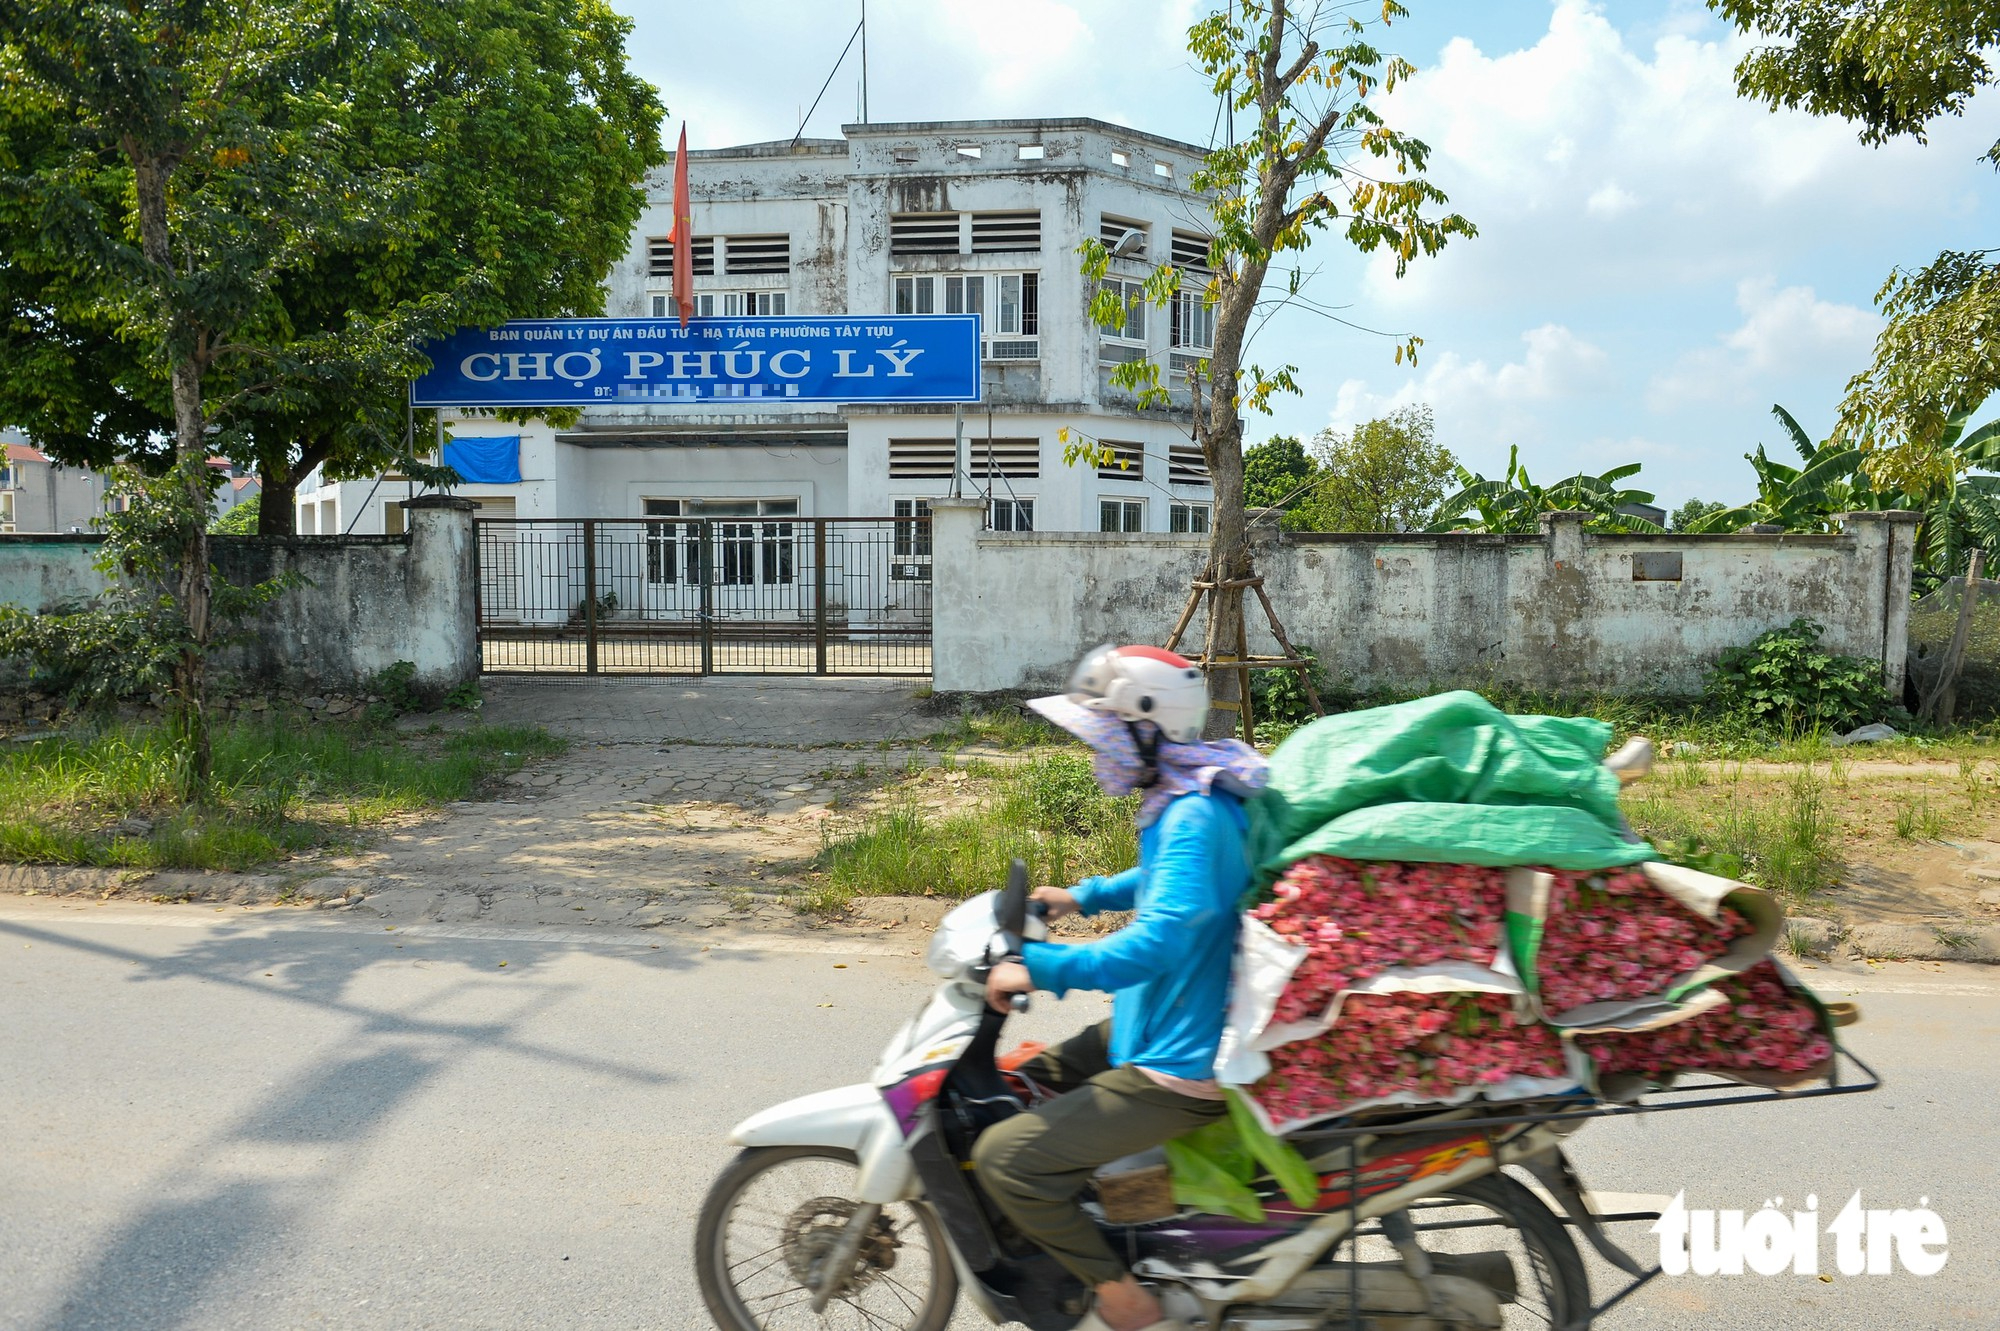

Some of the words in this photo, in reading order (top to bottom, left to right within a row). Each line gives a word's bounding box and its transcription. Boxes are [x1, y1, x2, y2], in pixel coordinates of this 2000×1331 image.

[489, 330, 520, 341] BAN
[524, 326, 564, 341] QUẢN
[568, 327, 585, 340] LÝ
[588, 328, 610, 341] DỰ
[612, 327, 633, 339] ÁN
[670, 327, 690, 339] TƯ
[703, 327, 723, 340] HẠ
[770, 324, 830, 338] PHƯỜNG
[834, 324, 861, 337] TÂY
[865, 325, 894, 339] TỰU
[460, 347, 602, 388] CHỢ
[622, 340, 811, 379] PHÚC
[832, 339, 925, 377] LÝ
[594, 386, 613, 397] ĐT:
